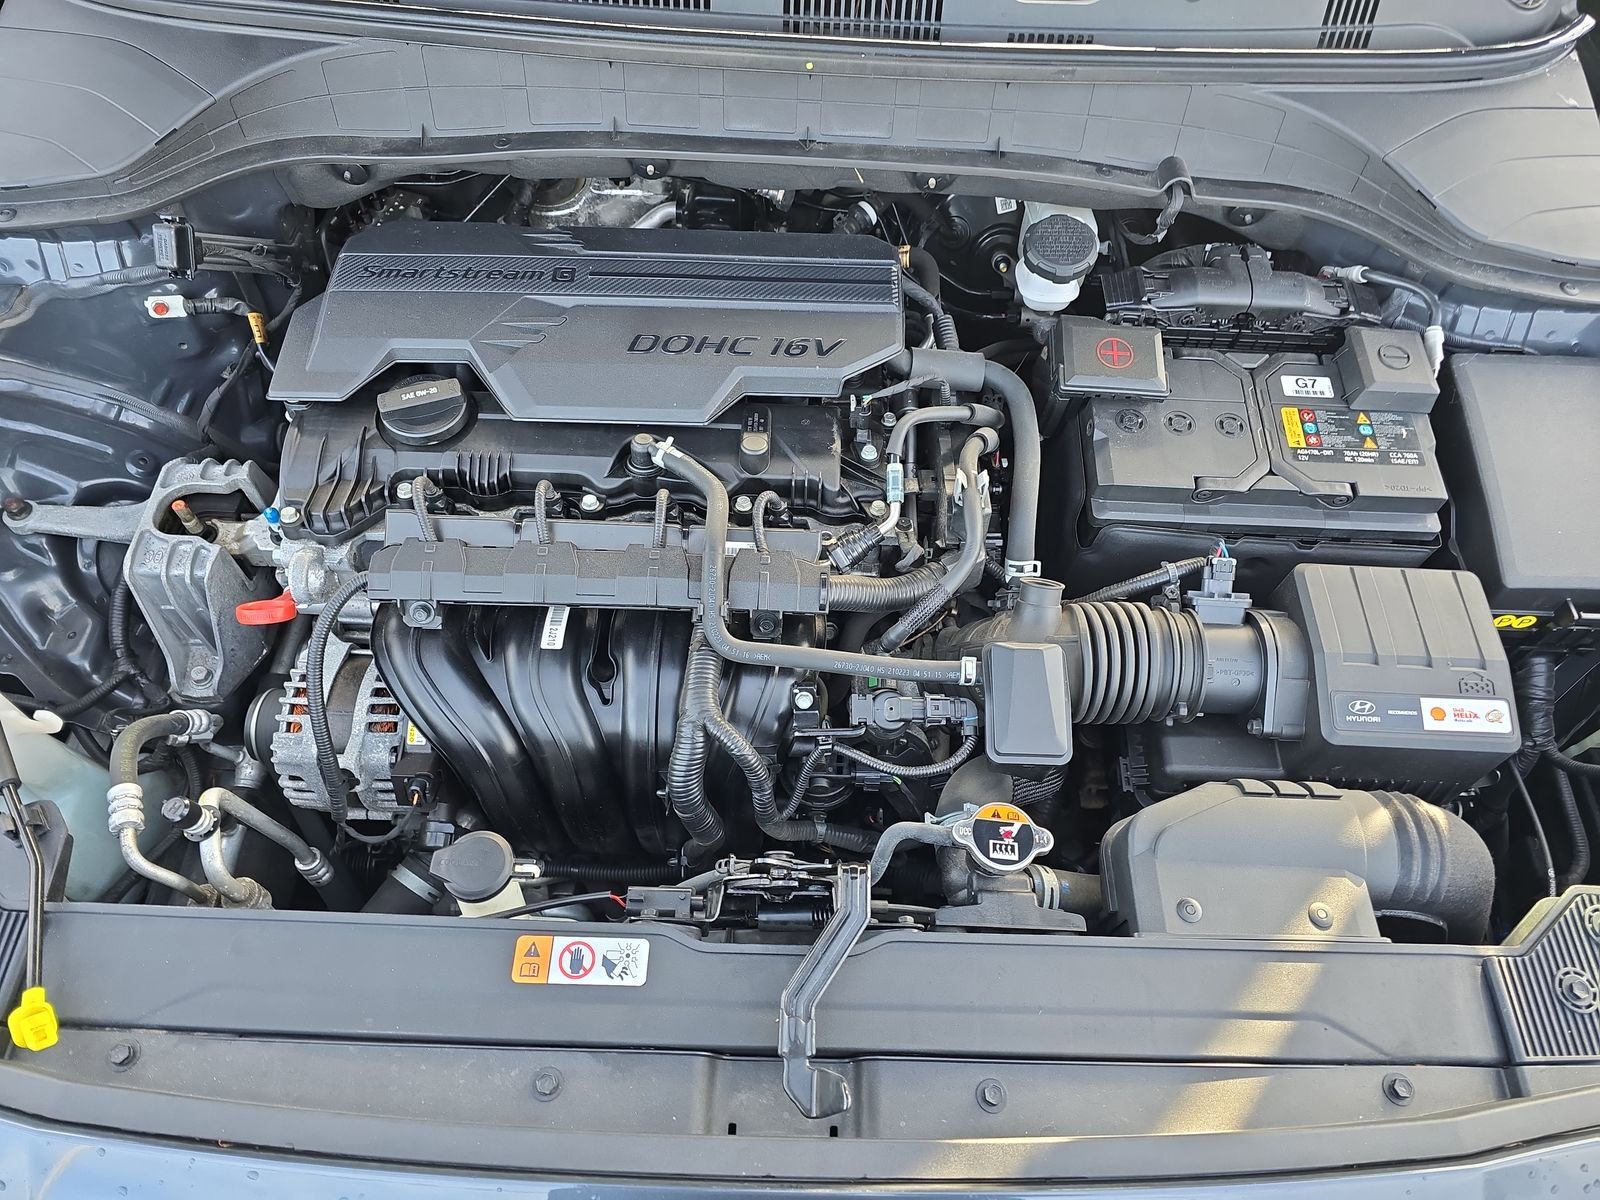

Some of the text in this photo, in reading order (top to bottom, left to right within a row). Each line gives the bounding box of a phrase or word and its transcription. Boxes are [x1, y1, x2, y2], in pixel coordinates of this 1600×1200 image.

[358, 265, 545, 280] Smartstream
[626, 334, 847, 358] DOHC 16V
[1295, 377, 1317, 389] G7
[547, 627, 558, 647] 2J210
